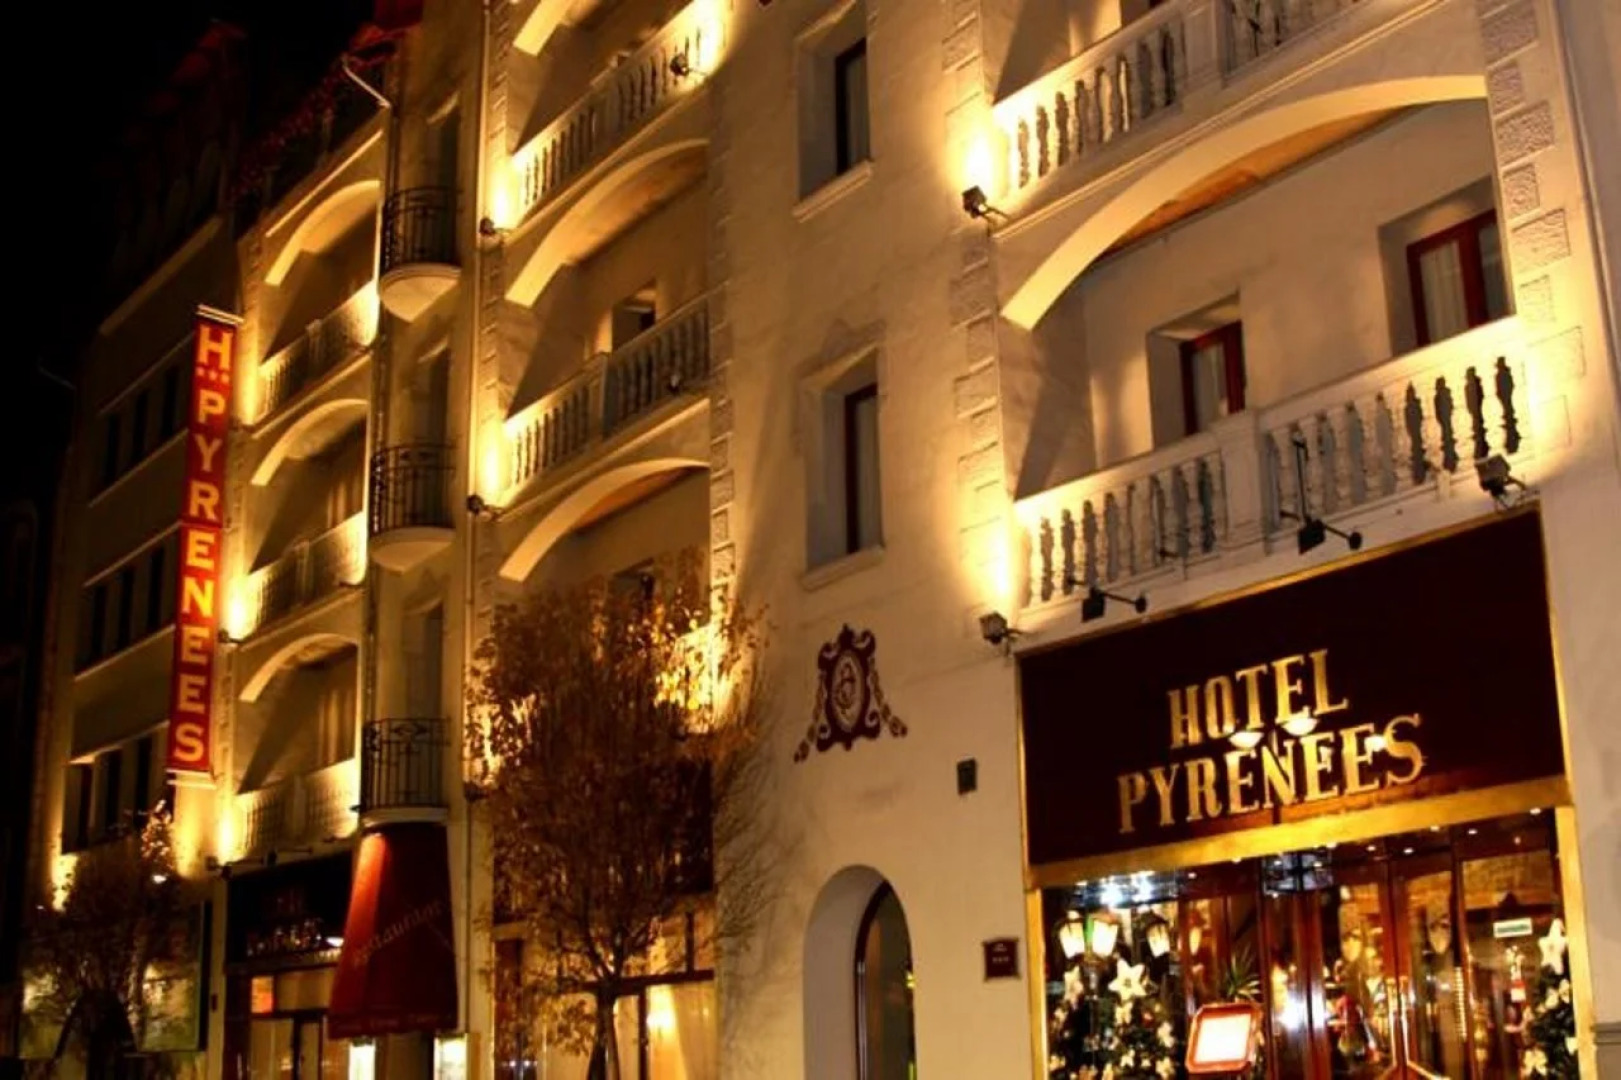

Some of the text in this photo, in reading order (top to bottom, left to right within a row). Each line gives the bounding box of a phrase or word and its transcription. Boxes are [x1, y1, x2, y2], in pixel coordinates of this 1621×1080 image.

[174, 389, 226, 762] PYRENEES
[1167, 649, 1348, 749] HOTEL
[1116, 713, 1422, 833] PYRENEES
